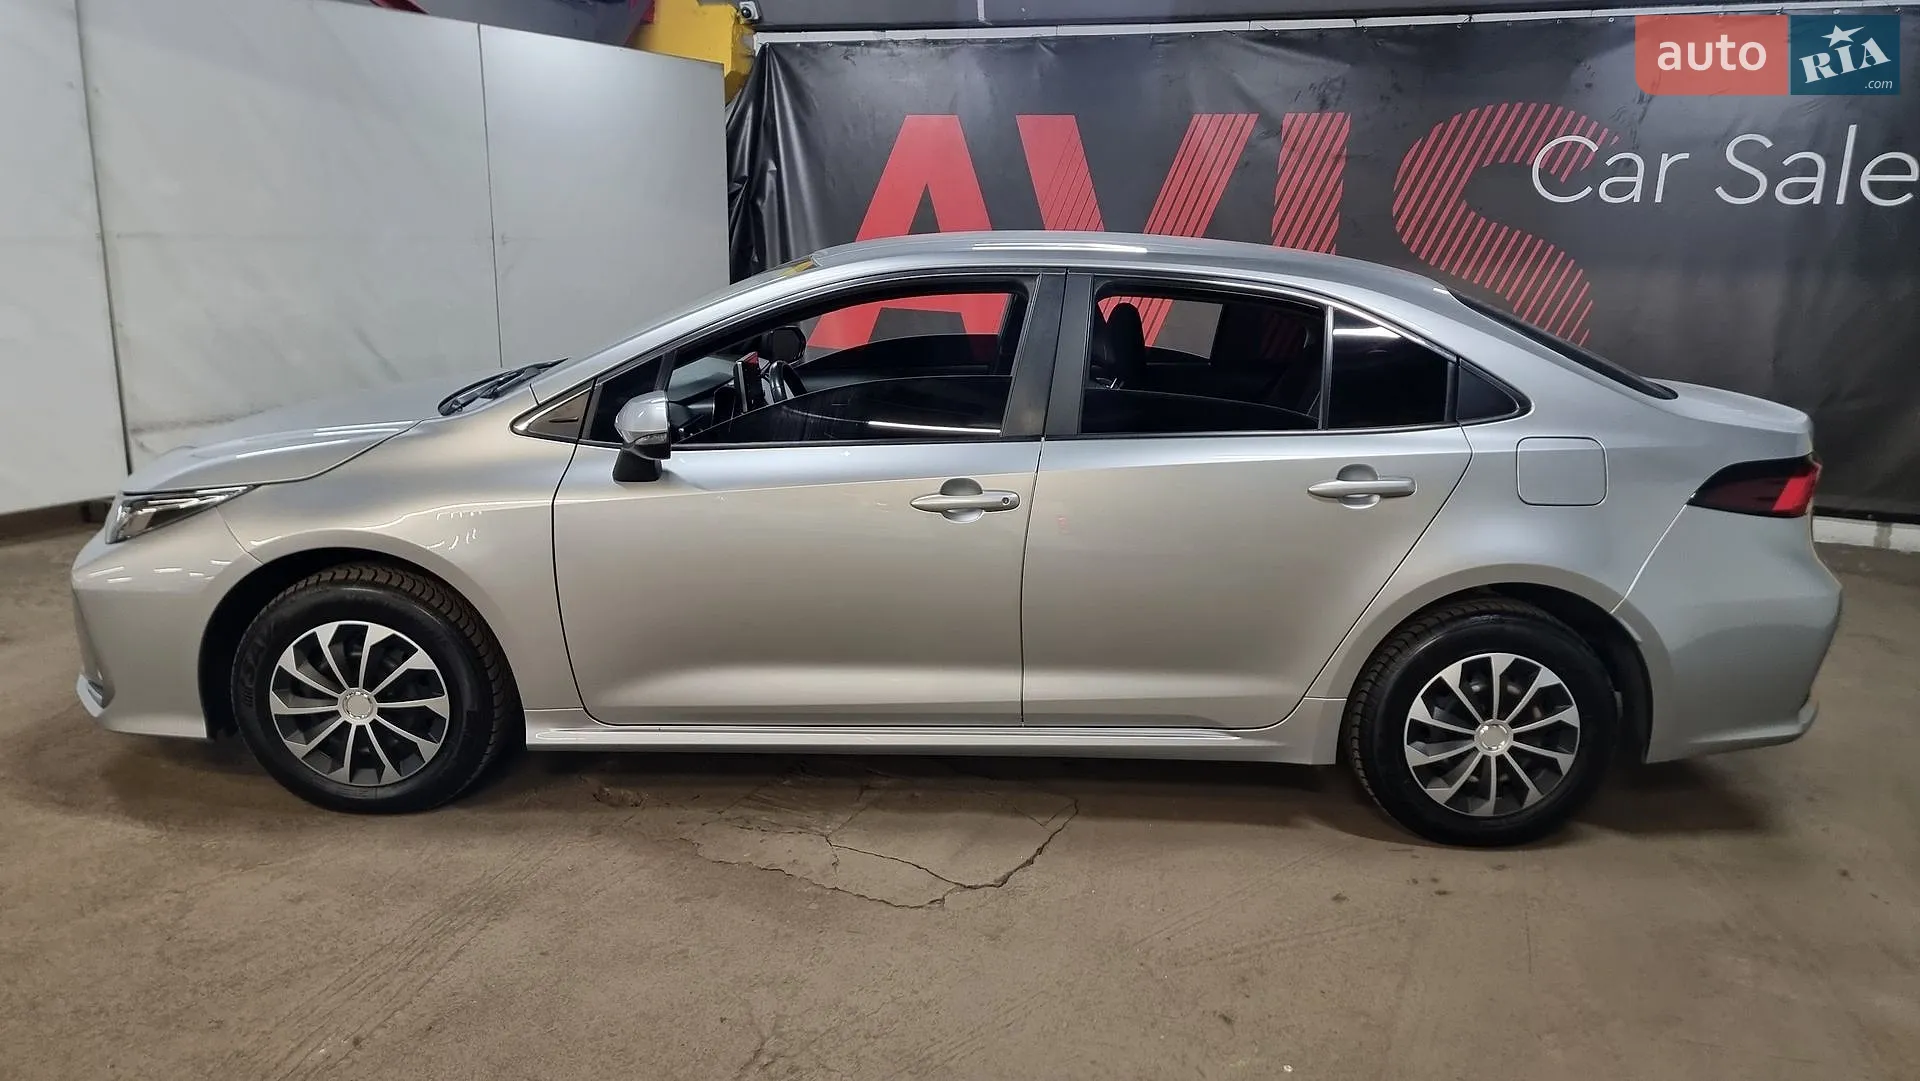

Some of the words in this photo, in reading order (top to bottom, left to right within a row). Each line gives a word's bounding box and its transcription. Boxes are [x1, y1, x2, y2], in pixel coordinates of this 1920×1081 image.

[808, 102, 1621, 348] AVIS
[1531, 135, 1690, 204] Car
[1714, 124, 1920, 207] Sale
